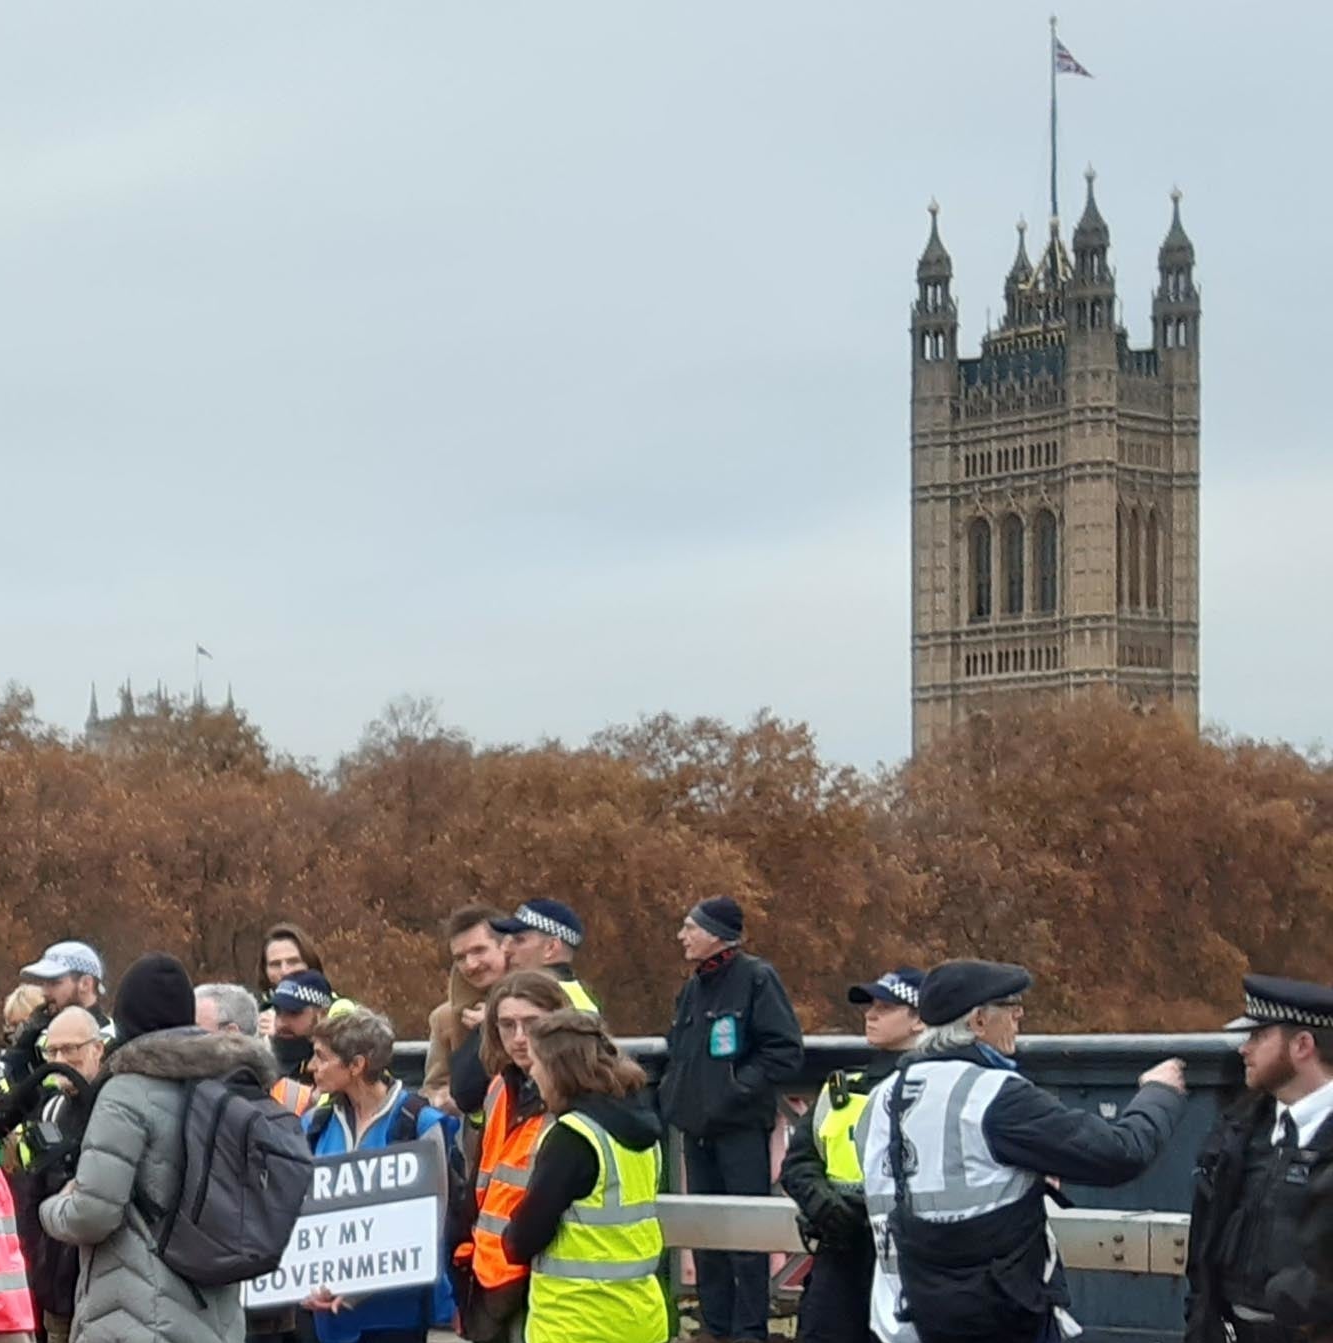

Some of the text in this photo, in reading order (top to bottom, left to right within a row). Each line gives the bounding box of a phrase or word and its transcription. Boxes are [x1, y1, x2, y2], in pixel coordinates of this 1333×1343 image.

[304, 1151, 419, 1201] RAYED
[297, 1217, 376, 1251] BY MY
[251, 1246, 423, 1293] GOVERNMENT
